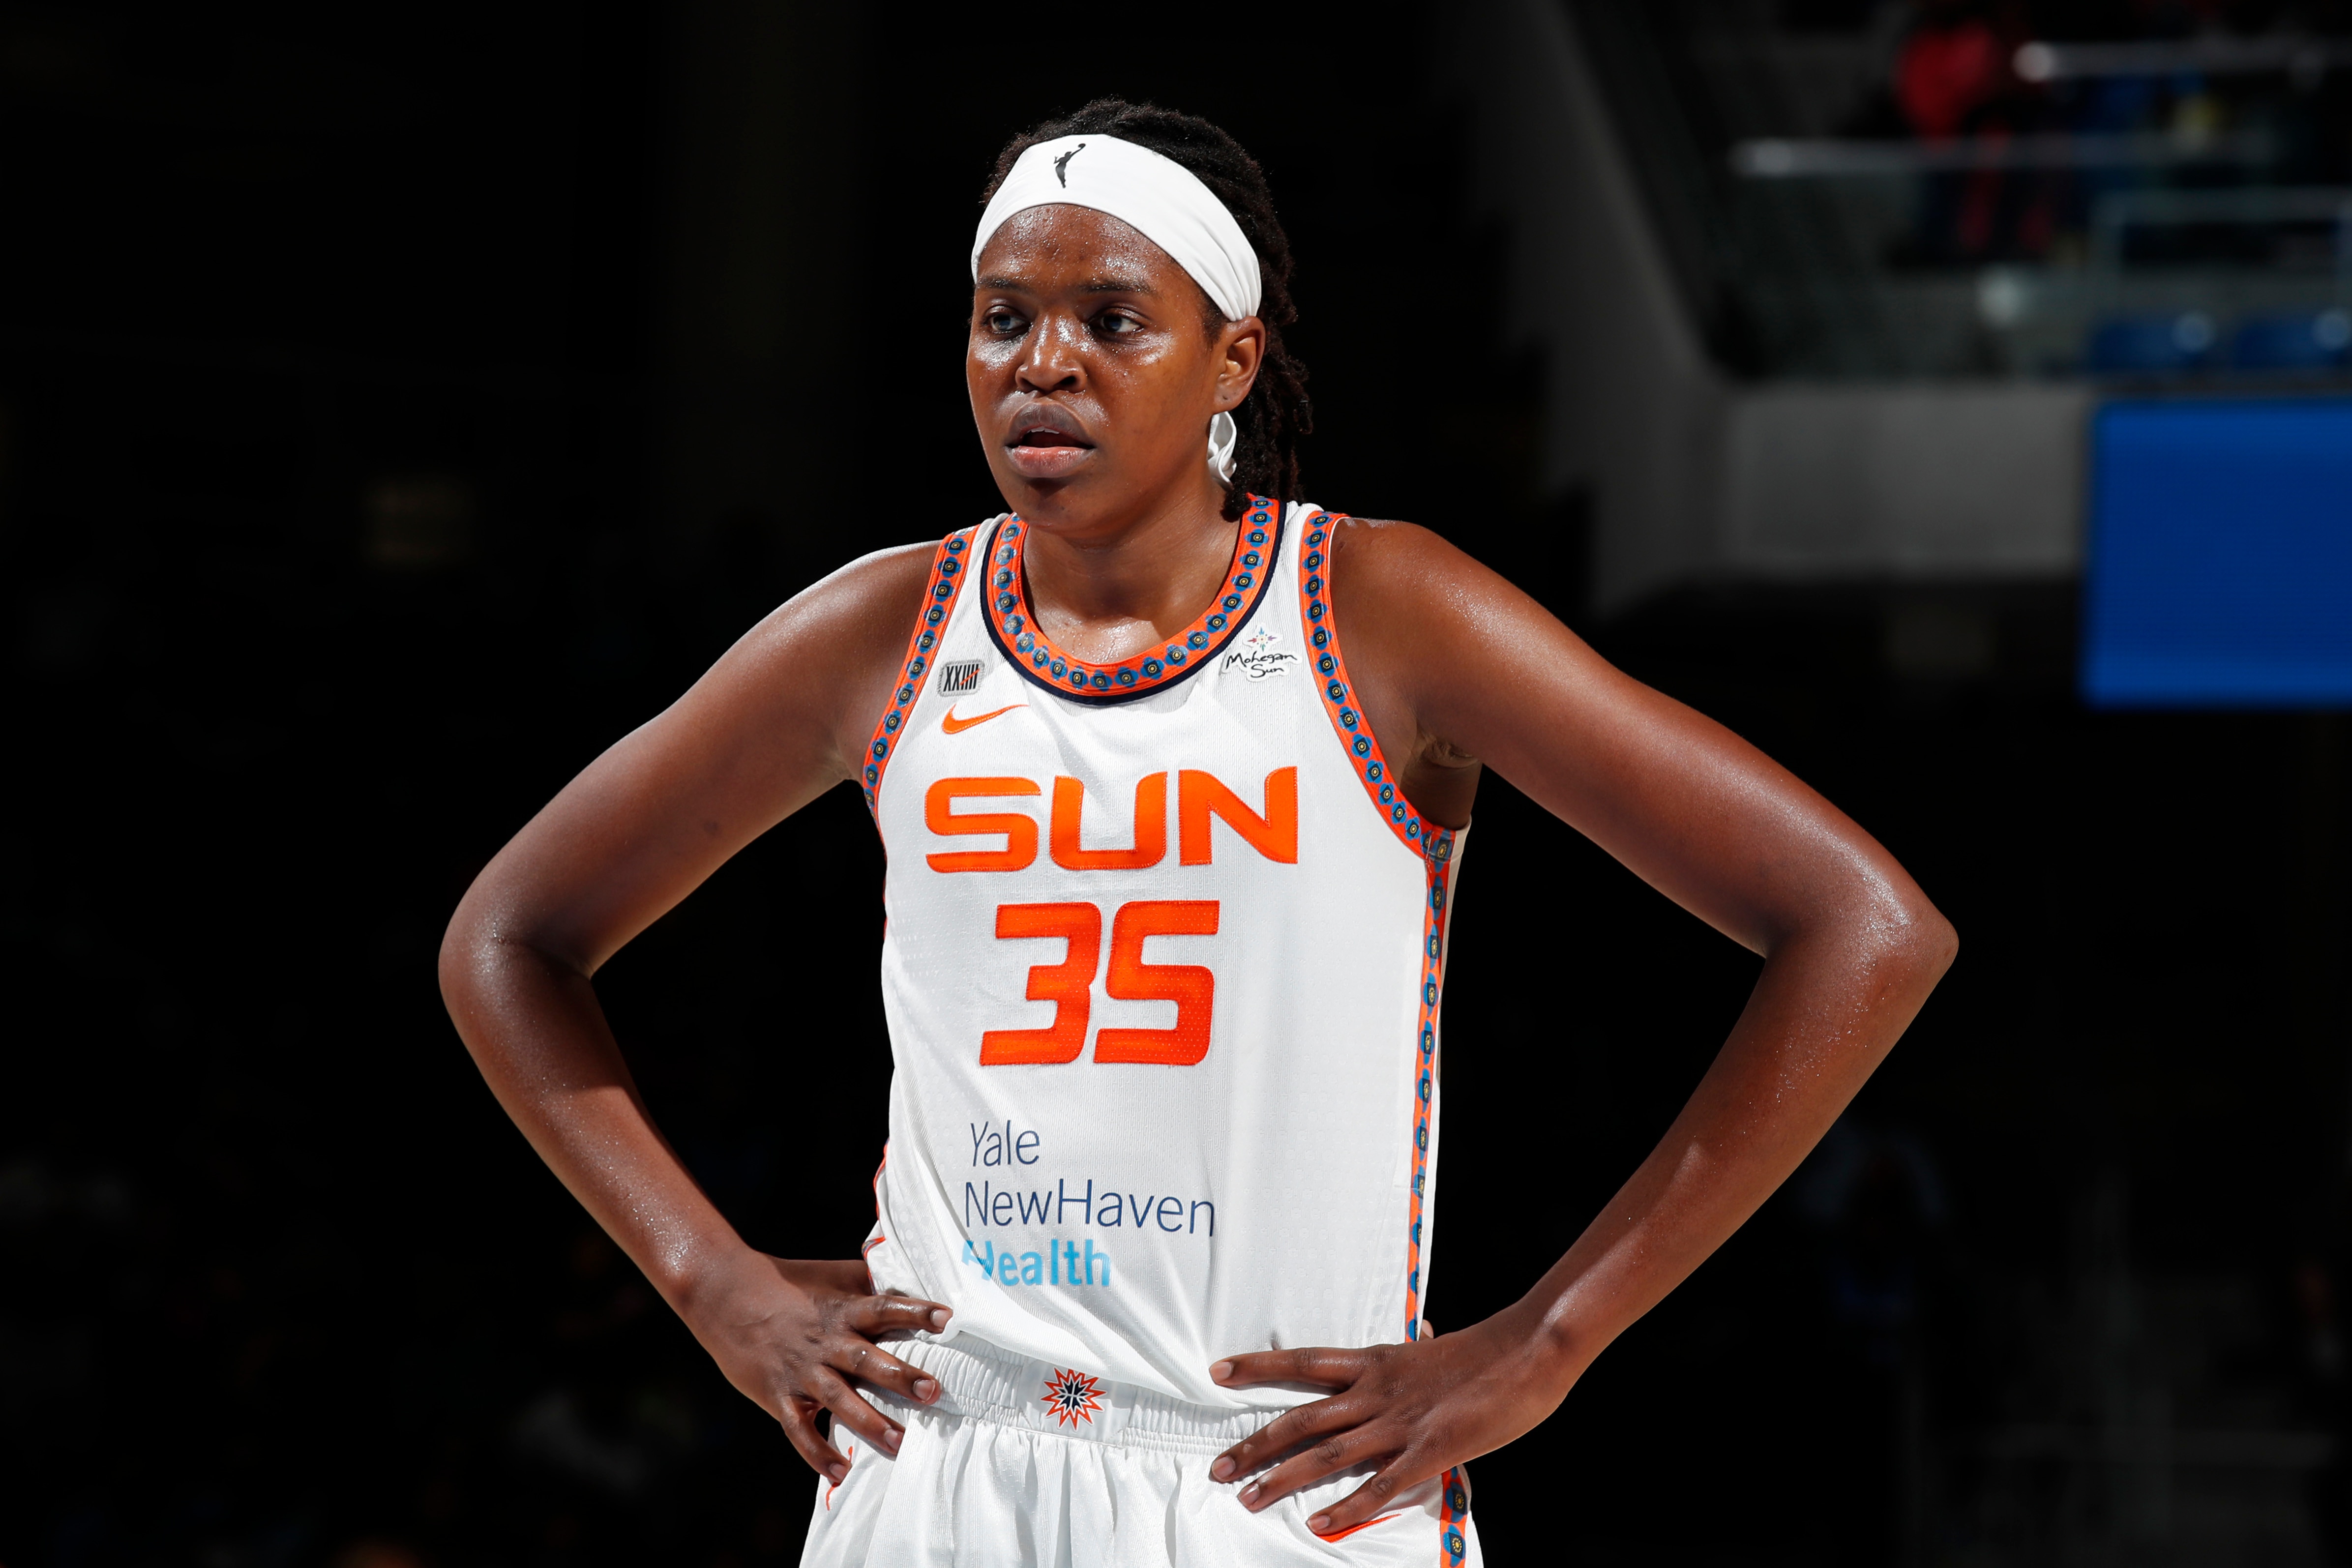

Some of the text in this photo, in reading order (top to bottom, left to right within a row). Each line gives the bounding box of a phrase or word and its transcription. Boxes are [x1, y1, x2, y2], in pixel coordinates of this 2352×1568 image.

[1226, 651, 1297, 669] Mohegan
[1250, 664, 1284, 678] Sun
[924, 766, 1298, 873] SUN
[979, 900, 1220, 1066] 35
[970, 1120, 1040, 1167] Yale
[965, 1179, 1215, 1237] NewHaven
